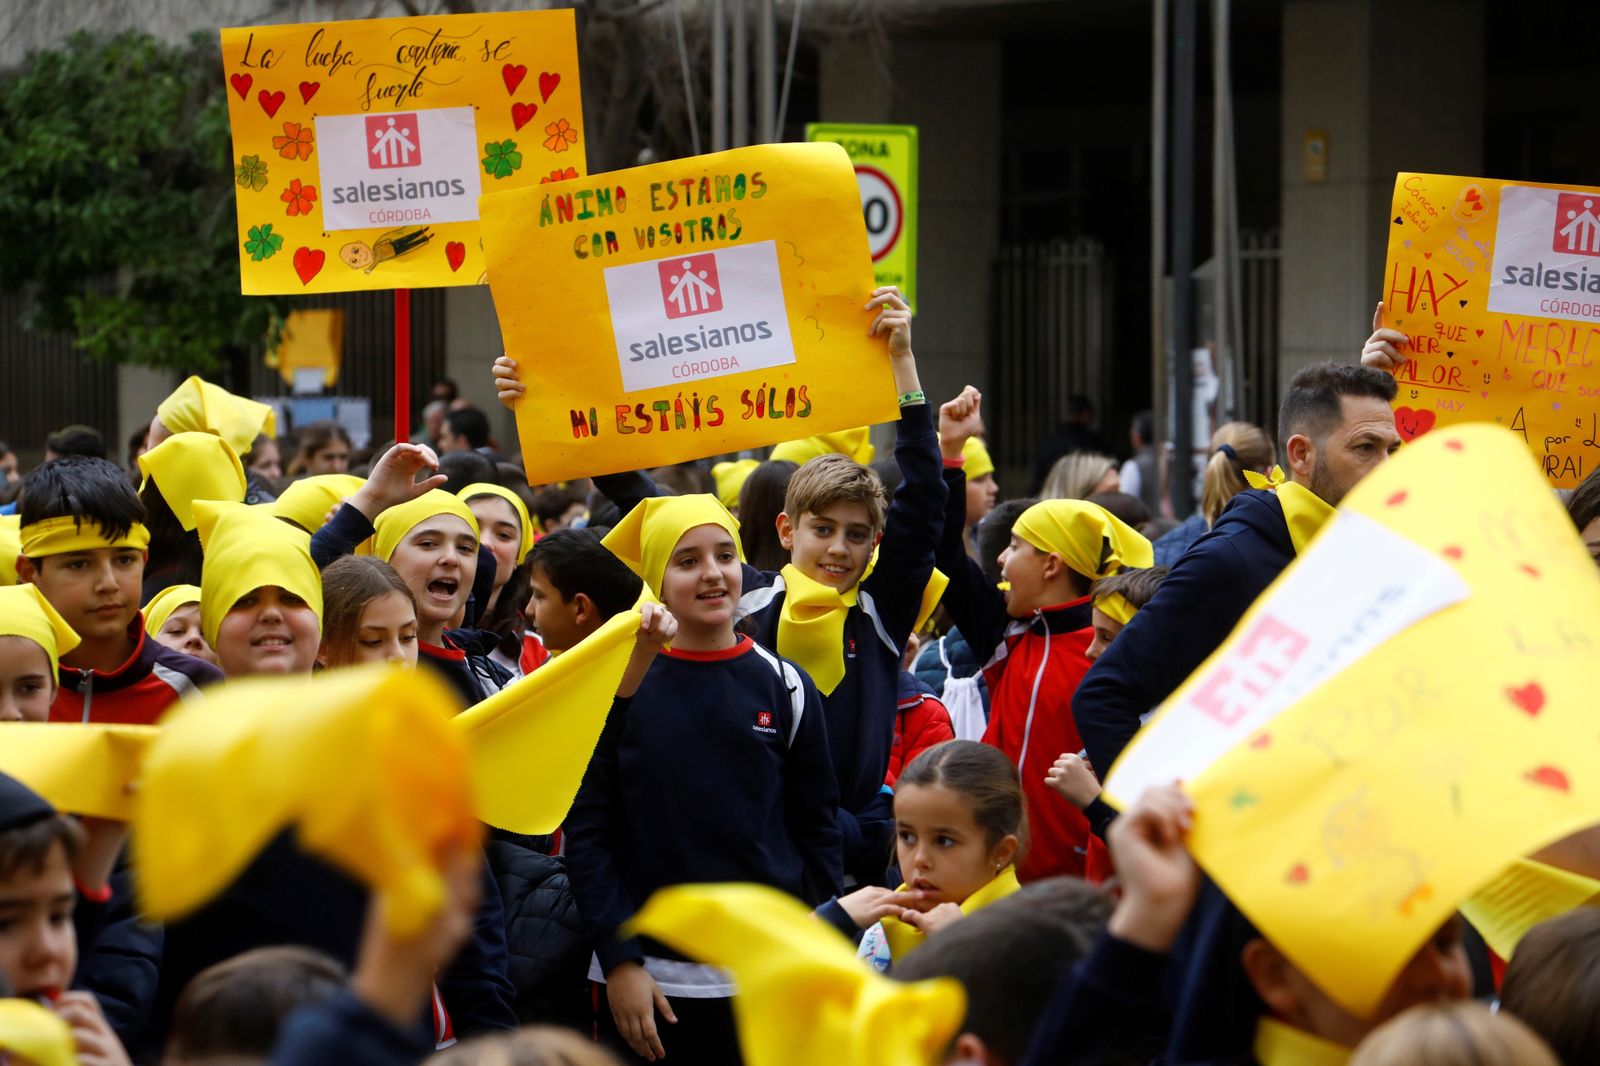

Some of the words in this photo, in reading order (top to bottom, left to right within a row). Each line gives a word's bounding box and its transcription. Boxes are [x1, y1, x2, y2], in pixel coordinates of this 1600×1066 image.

[240, 32, 285, 69] La
[304, 28, 363, 77] lucha
[836, 139, 890, 158] ONA
[332, 177, 466, 205] salesianos
[650, 171, 768, 213] ESTAMOS
[369, 207, 432, 225] CÓRDOBA
[573, 230, 619, 260] CON
[634, 208, 742, 251] VOSOTROS
[865, 197, 890, 235] 0
[1390, 261, 1469, 317] HAY
[628, 320, 773, 363] salesianos
[671, 356, 740, 379] CÓRDOBA
[1544, 436, 1571, 453] por
